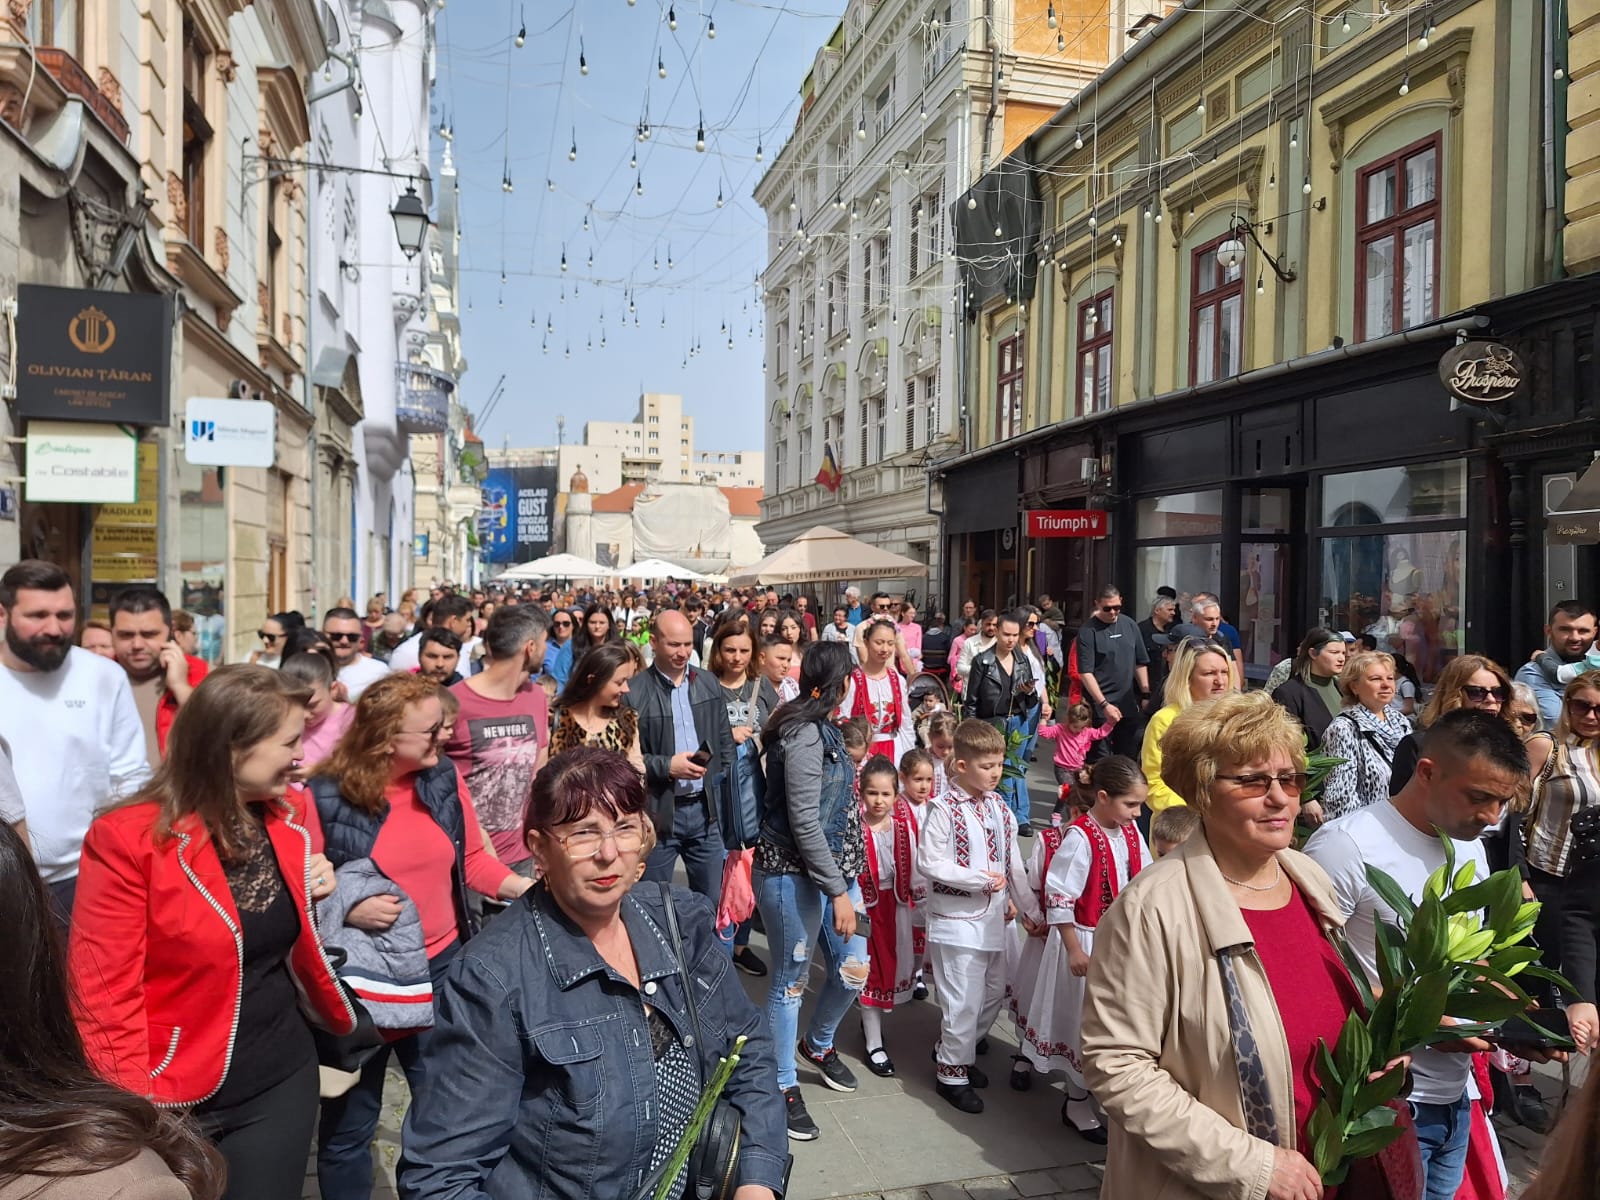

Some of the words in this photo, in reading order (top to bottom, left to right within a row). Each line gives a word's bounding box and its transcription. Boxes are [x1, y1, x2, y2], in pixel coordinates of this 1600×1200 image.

[27, 364, 94, 379] OLIVIAN
[1449, 360, 1521, 394] Prospero
[518, 498, 547, 516] GUST
[517, 516, 548, 525] GROZAV
[1036, 515, 1088, 532] Triumph
[527, 525, 548, 534] NOU
[517, 534, 548, 542] DESIGN
